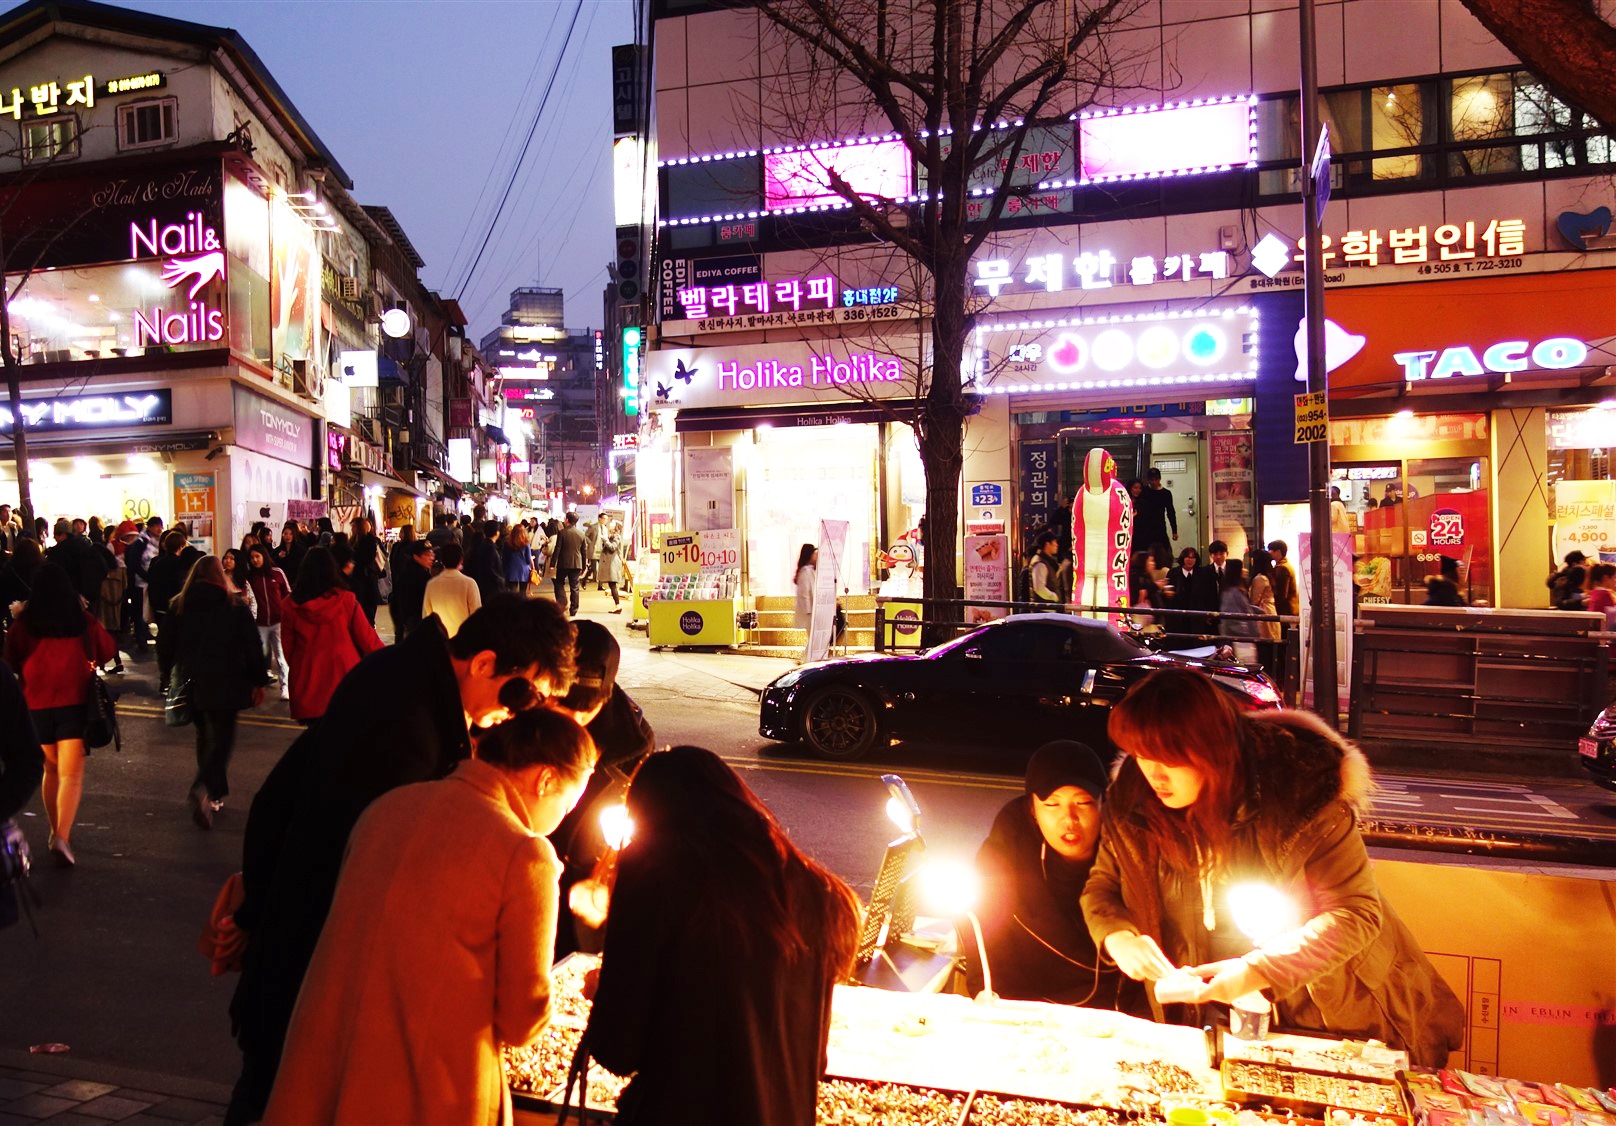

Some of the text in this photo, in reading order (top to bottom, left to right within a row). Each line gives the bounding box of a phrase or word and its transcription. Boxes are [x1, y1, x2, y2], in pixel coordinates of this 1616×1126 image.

[142, 181, 158, 202] &
[696, 266, 758, 278] EDIYA COFFEE
[974, 250, 1116, 296] 무제한
[1476, 258, 1522, 271] 722-3210
[662, 260, 674, 315] COFFEE
[680, 276, 836, 320] 벨라테라피
[843, 306, 899, 321] 336-1526
[133, 301, 224, 347] Nails
[1393, 337, 1588, 382] TACO
[716, 354, 902, 391] Holika Holika
[260, 409, 301, 438] TONYMOLY
[797, 417, 822, 426] Holika
[1297, 424, 1327, 442] 2002
[181, 493, 208, 513] 1+1
[1557, 504, 1615, 519] 런치스페셜
[1433, 521, 1462, 538] 24
[1568, 532, 1608, 543] 4,900
[700, 550, 736, 566] 10+10
[1530, 1006, 1573, 1018] EBLIN
